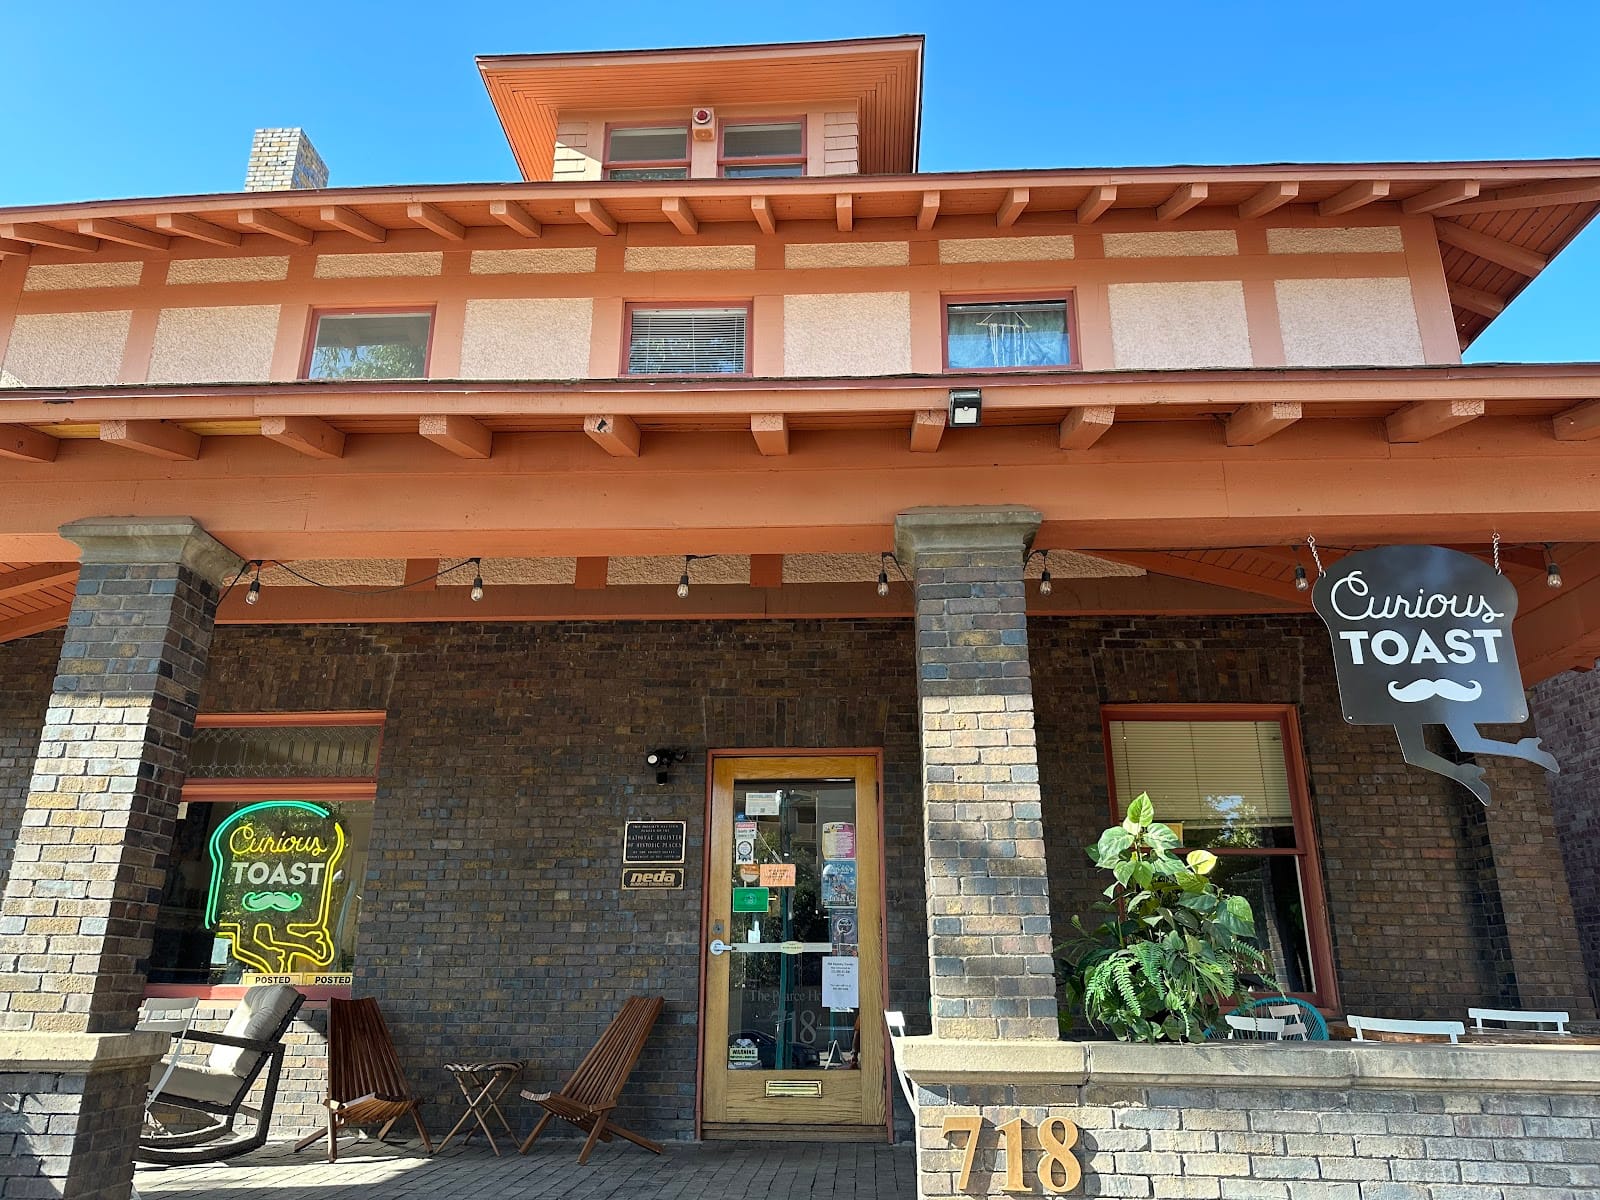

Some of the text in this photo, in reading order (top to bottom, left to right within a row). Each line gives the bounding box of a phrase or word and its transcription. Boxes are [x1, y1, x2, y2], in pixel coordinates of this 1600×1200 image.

[1330, 570, 1505, 624] Curious
[1339, 628, 1503, 666] TOAST
[229, 822, 328, 857] Curious
[231, 861, 326, 886] TOAST
[629, 870, 676, 883] neda
[255, 976, 291, 984] POSTED
[315, 976, 351, 984] POSTED
[772, 989, 805, 1002] Parce
[940, 1114, 1082, 1193] 718
